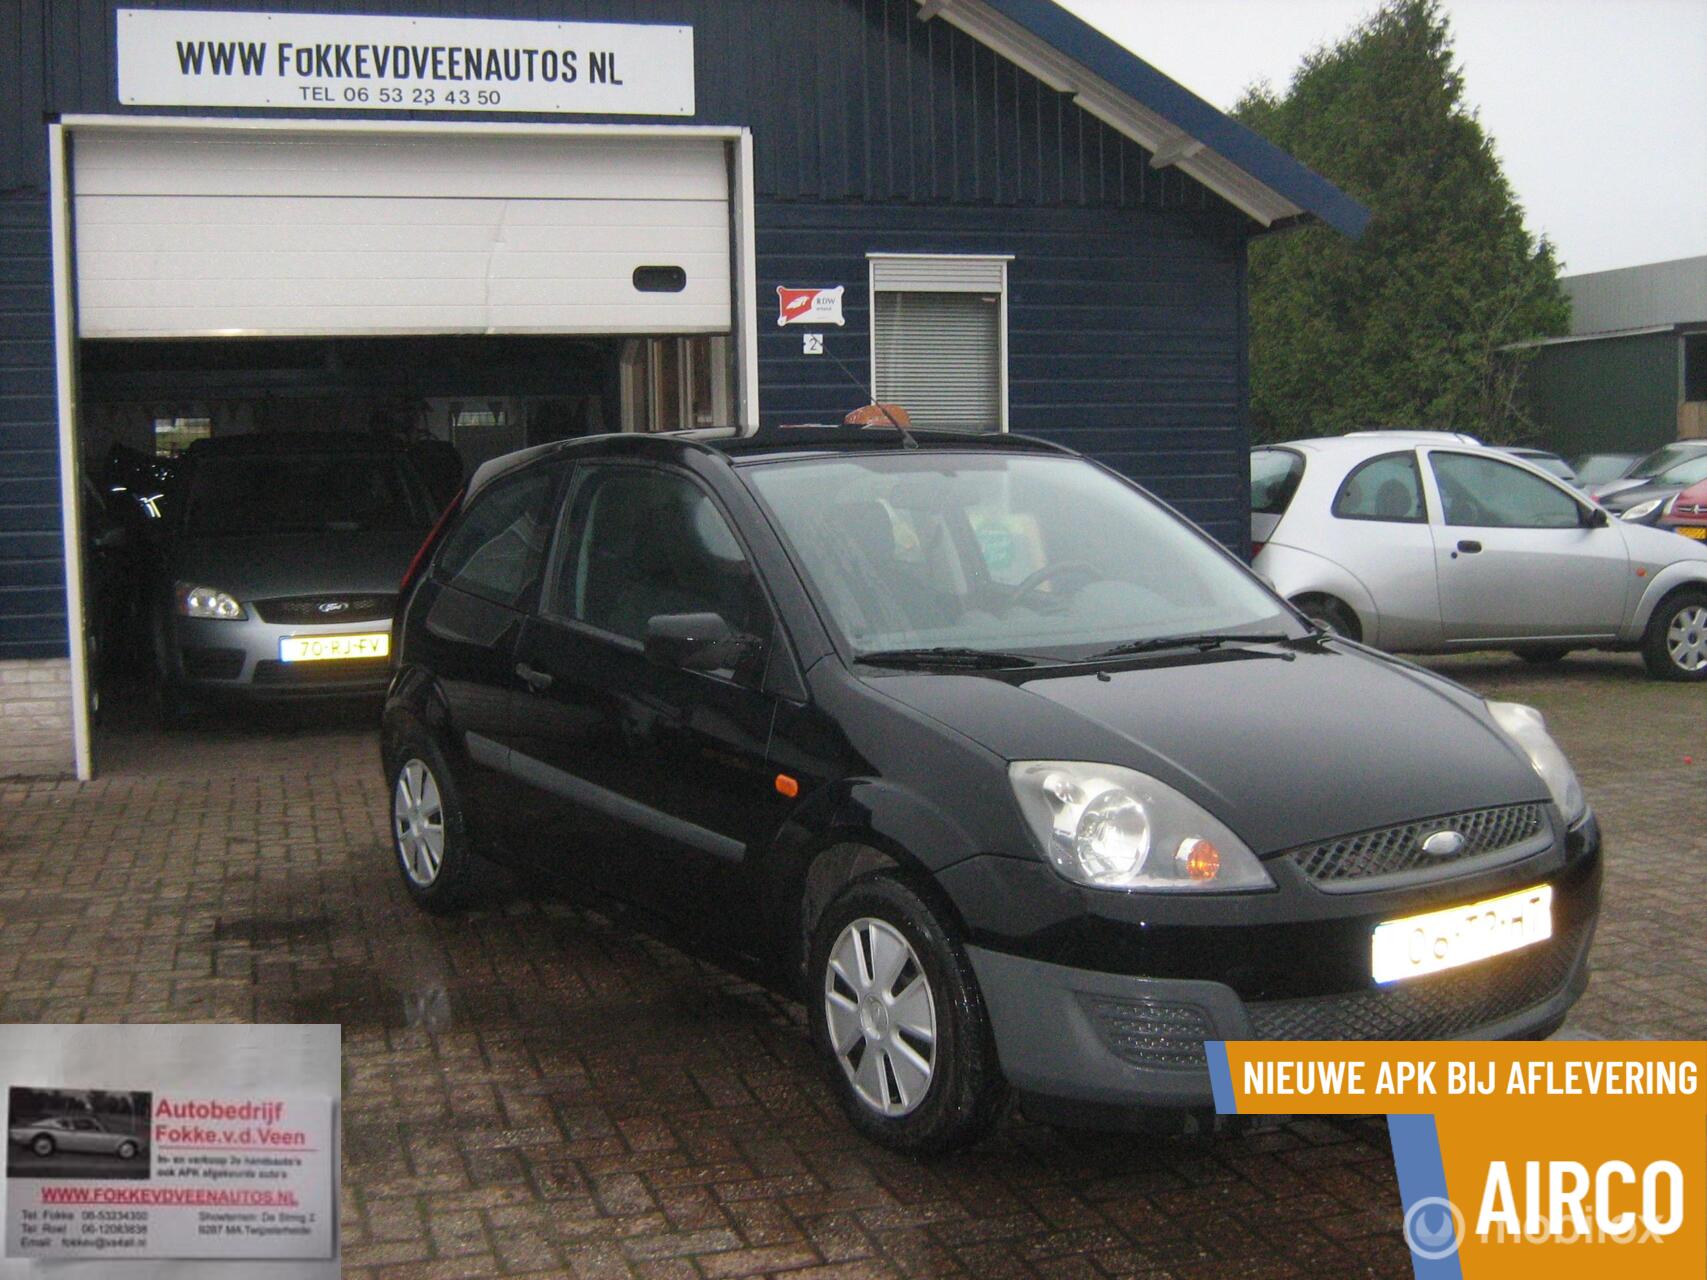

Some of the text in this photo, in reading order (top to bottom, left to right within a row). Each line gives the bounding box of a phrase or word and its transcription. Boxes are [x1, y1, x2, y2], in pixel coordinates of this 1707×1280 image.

[176, 41, 267, 76] WWW
[589, 51, 623, 85] NL
[299, 86, 501, 105] TEL 06 53 23 43 50
[808, 336, 818, 351] 2
